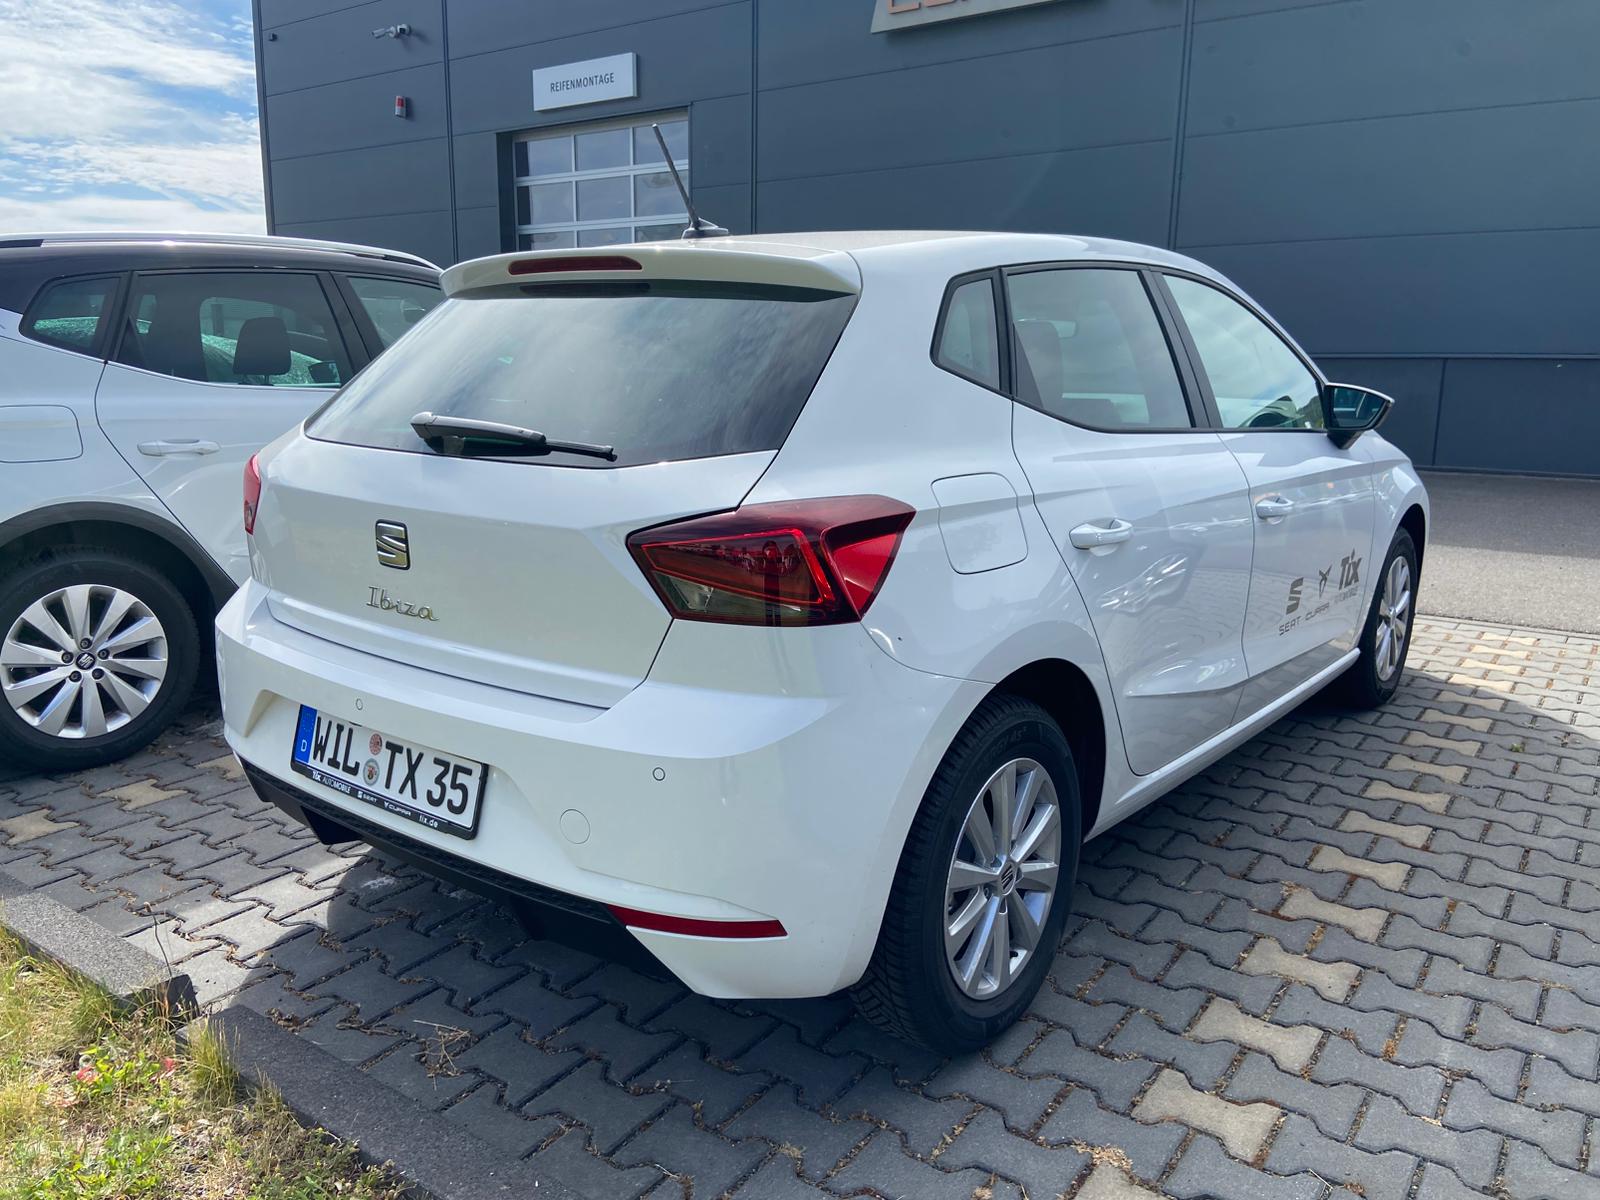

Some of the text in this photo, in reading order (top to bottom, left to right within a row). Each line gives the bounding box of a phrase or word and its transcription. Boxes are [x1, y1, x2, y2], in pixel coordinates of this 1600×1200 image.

[550, 72, 614, 93] REIFENMONTAGE
[366, 586, 440, 621] Ibiza
[300, 739, 308, 752] D
[312, 716, 473, 814] WIL TX 35
